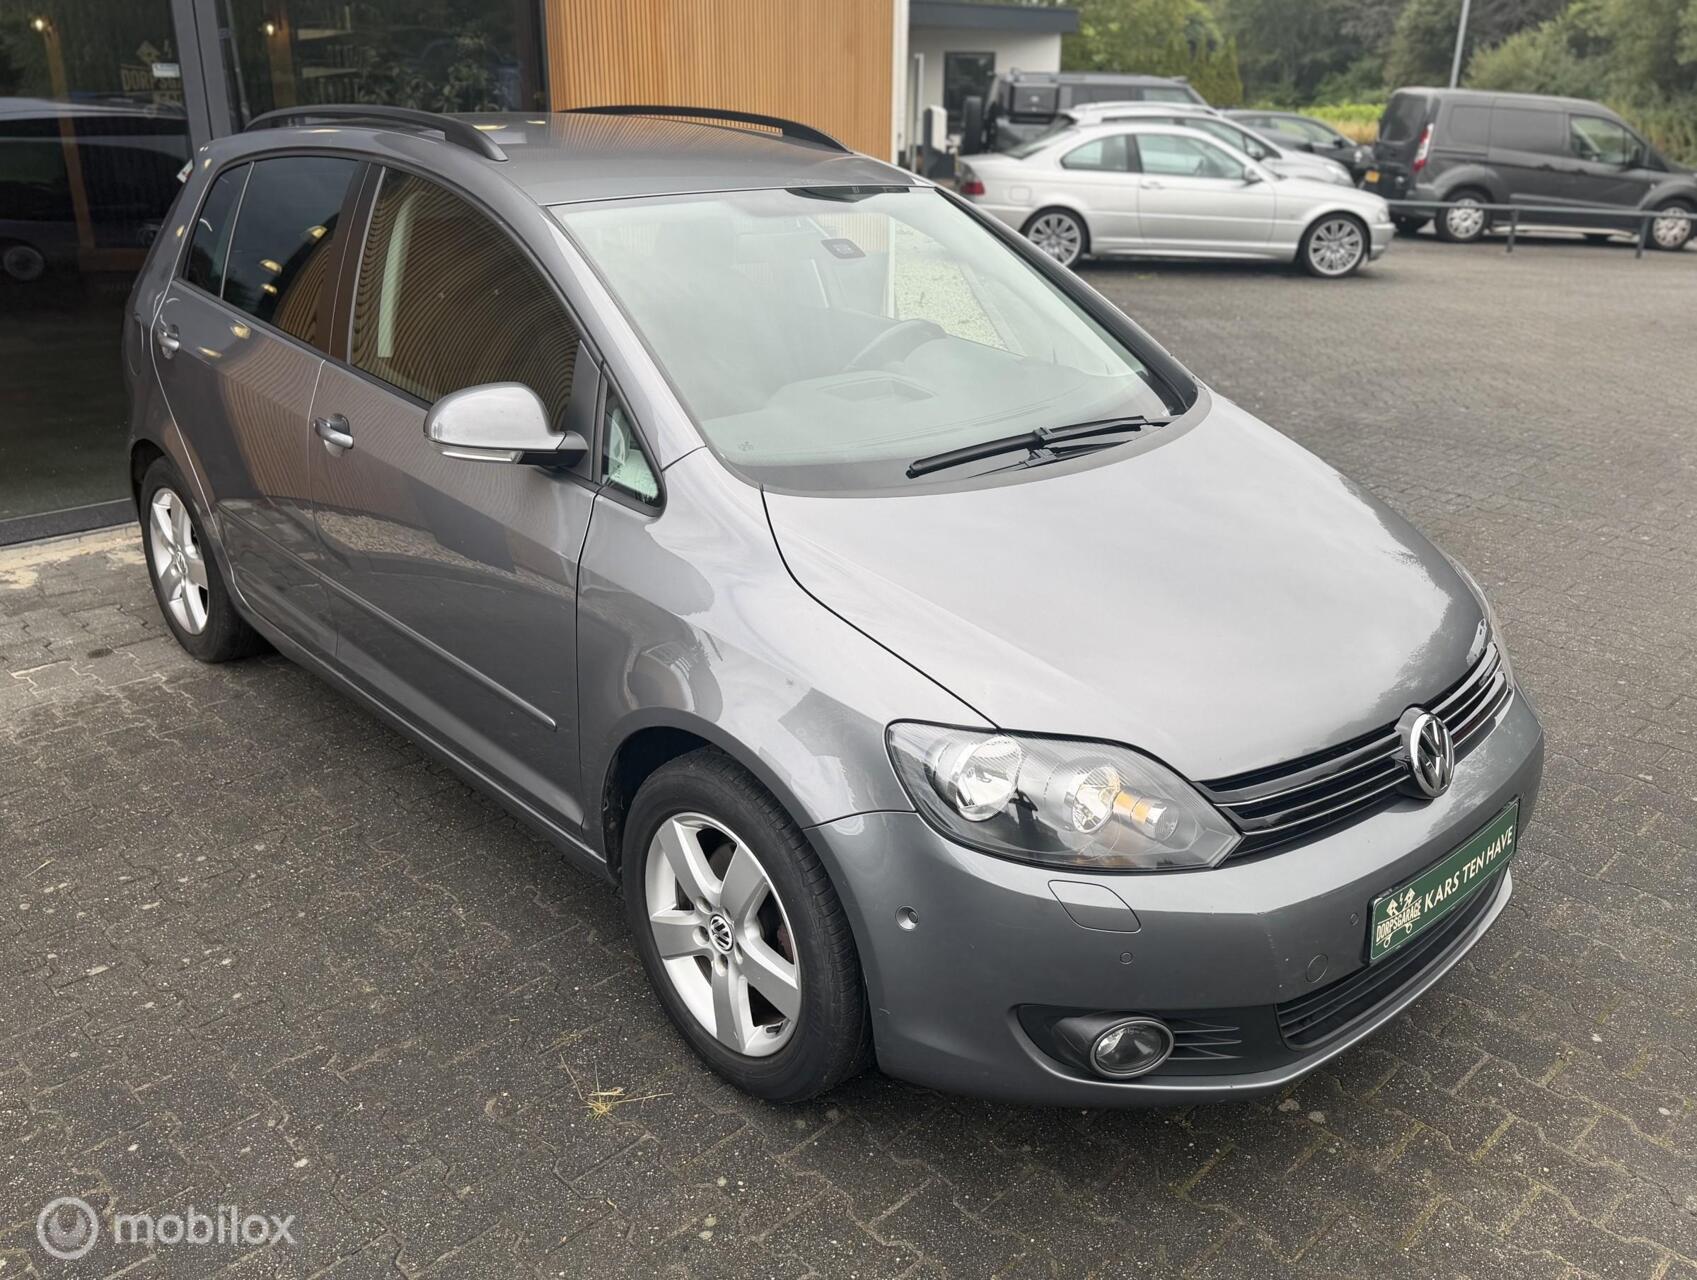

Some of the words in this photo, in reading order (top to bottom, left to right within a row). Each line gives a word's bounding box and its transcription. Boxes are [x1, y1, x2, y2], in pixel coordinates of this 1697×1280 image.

[1376, 899, 1422, 942] DORPSGARAGE
[1424, 871, 1460, 912] KARS
[1462, 851, 1485, 883] TEN
[1486, 825, 1513, 864] HAVE
